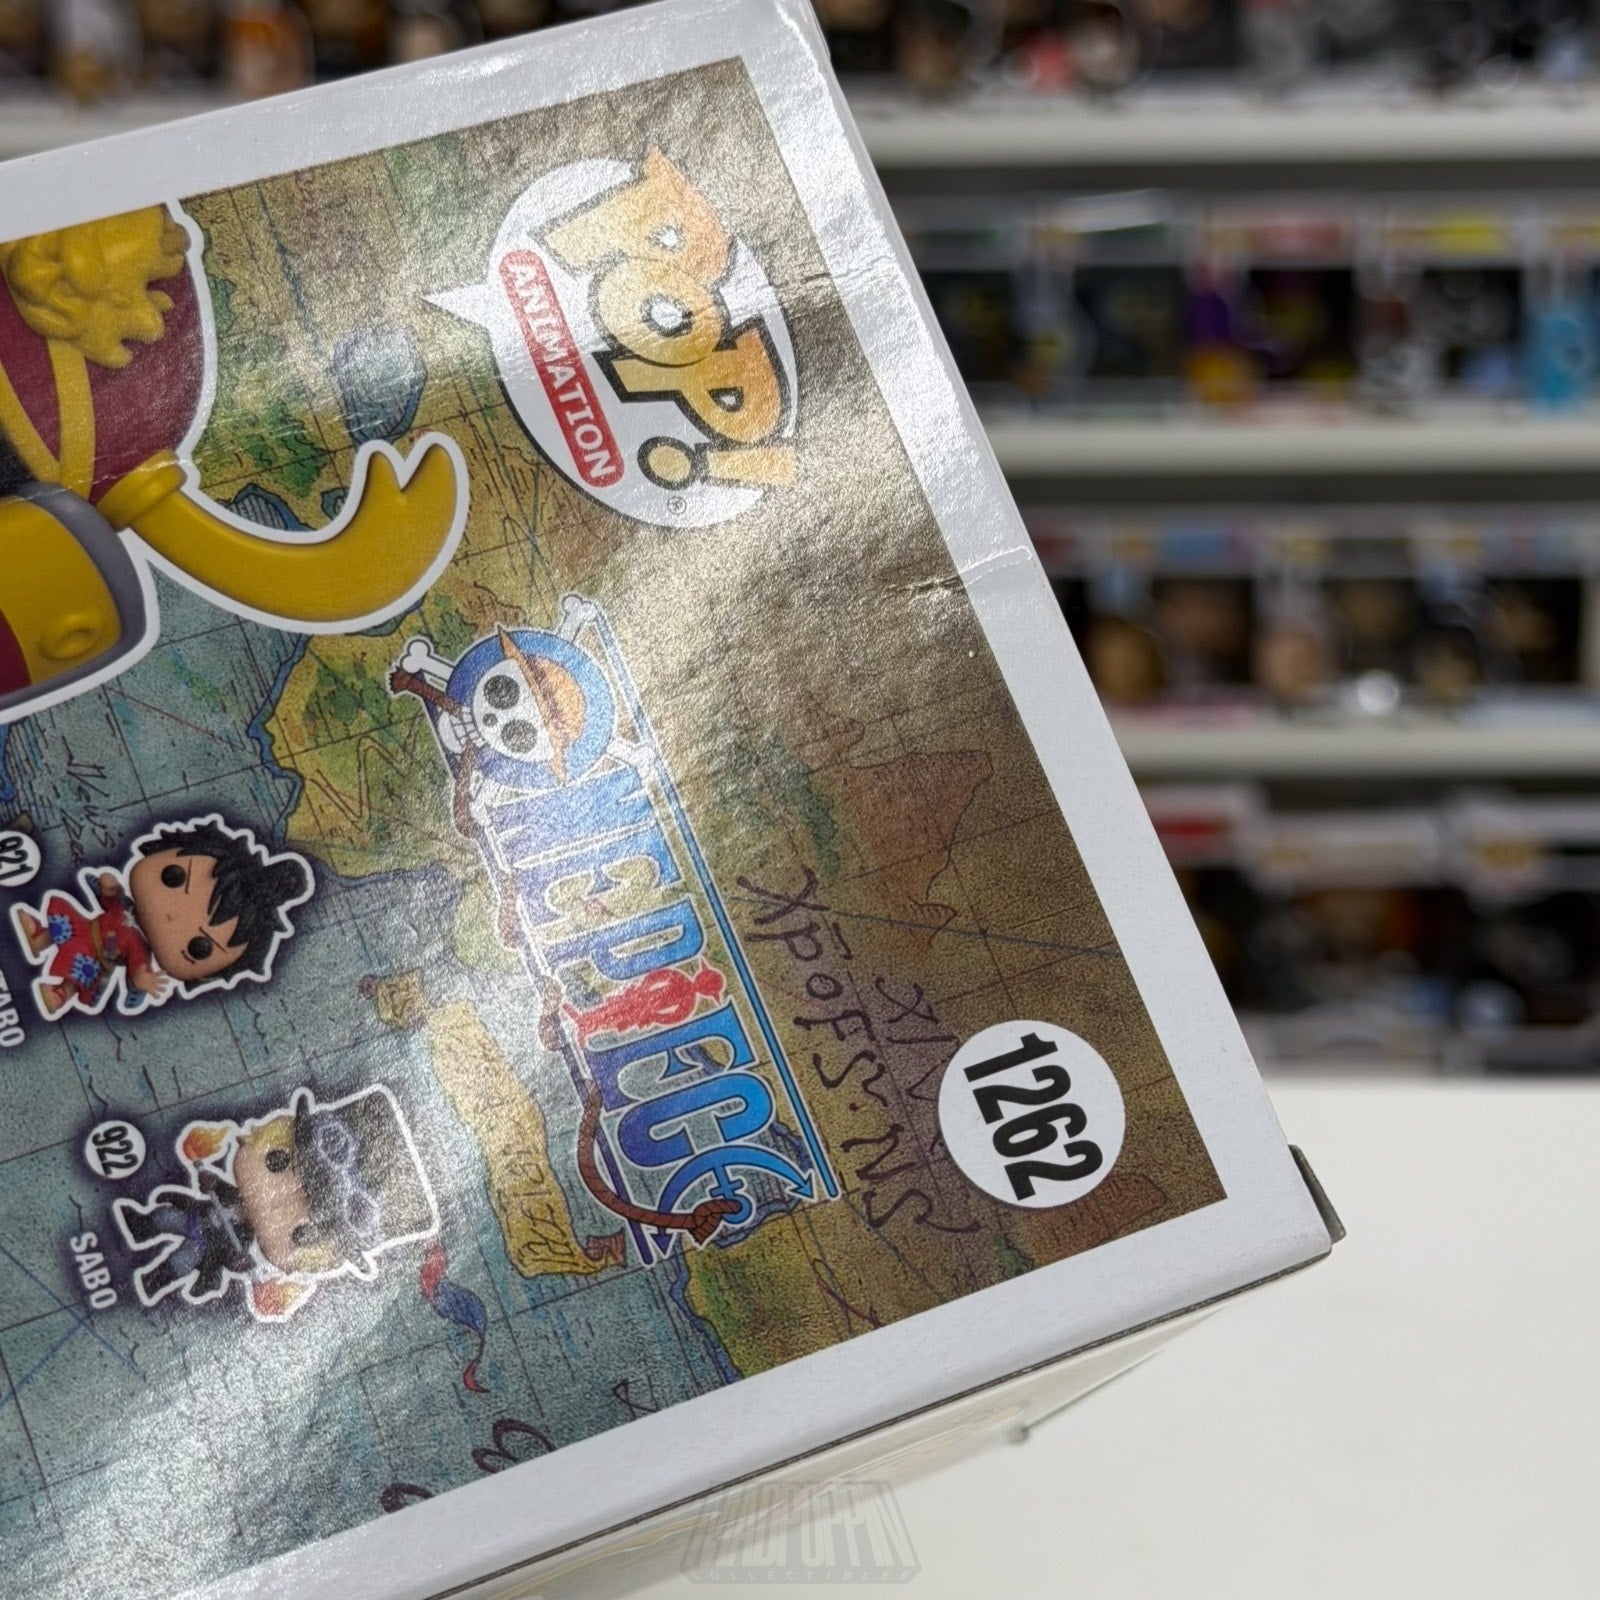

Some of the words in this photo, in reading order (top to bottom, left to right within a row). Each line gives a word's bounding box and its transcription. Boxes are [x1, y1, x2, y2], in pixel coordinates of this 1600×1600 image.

[504, 260, 616, 479] ANIMATION
[91, 1125, 137, 1176] 922
[964, 1033, 1103, 1201] 1262
[71, 1230, 118, 1309] SABO
